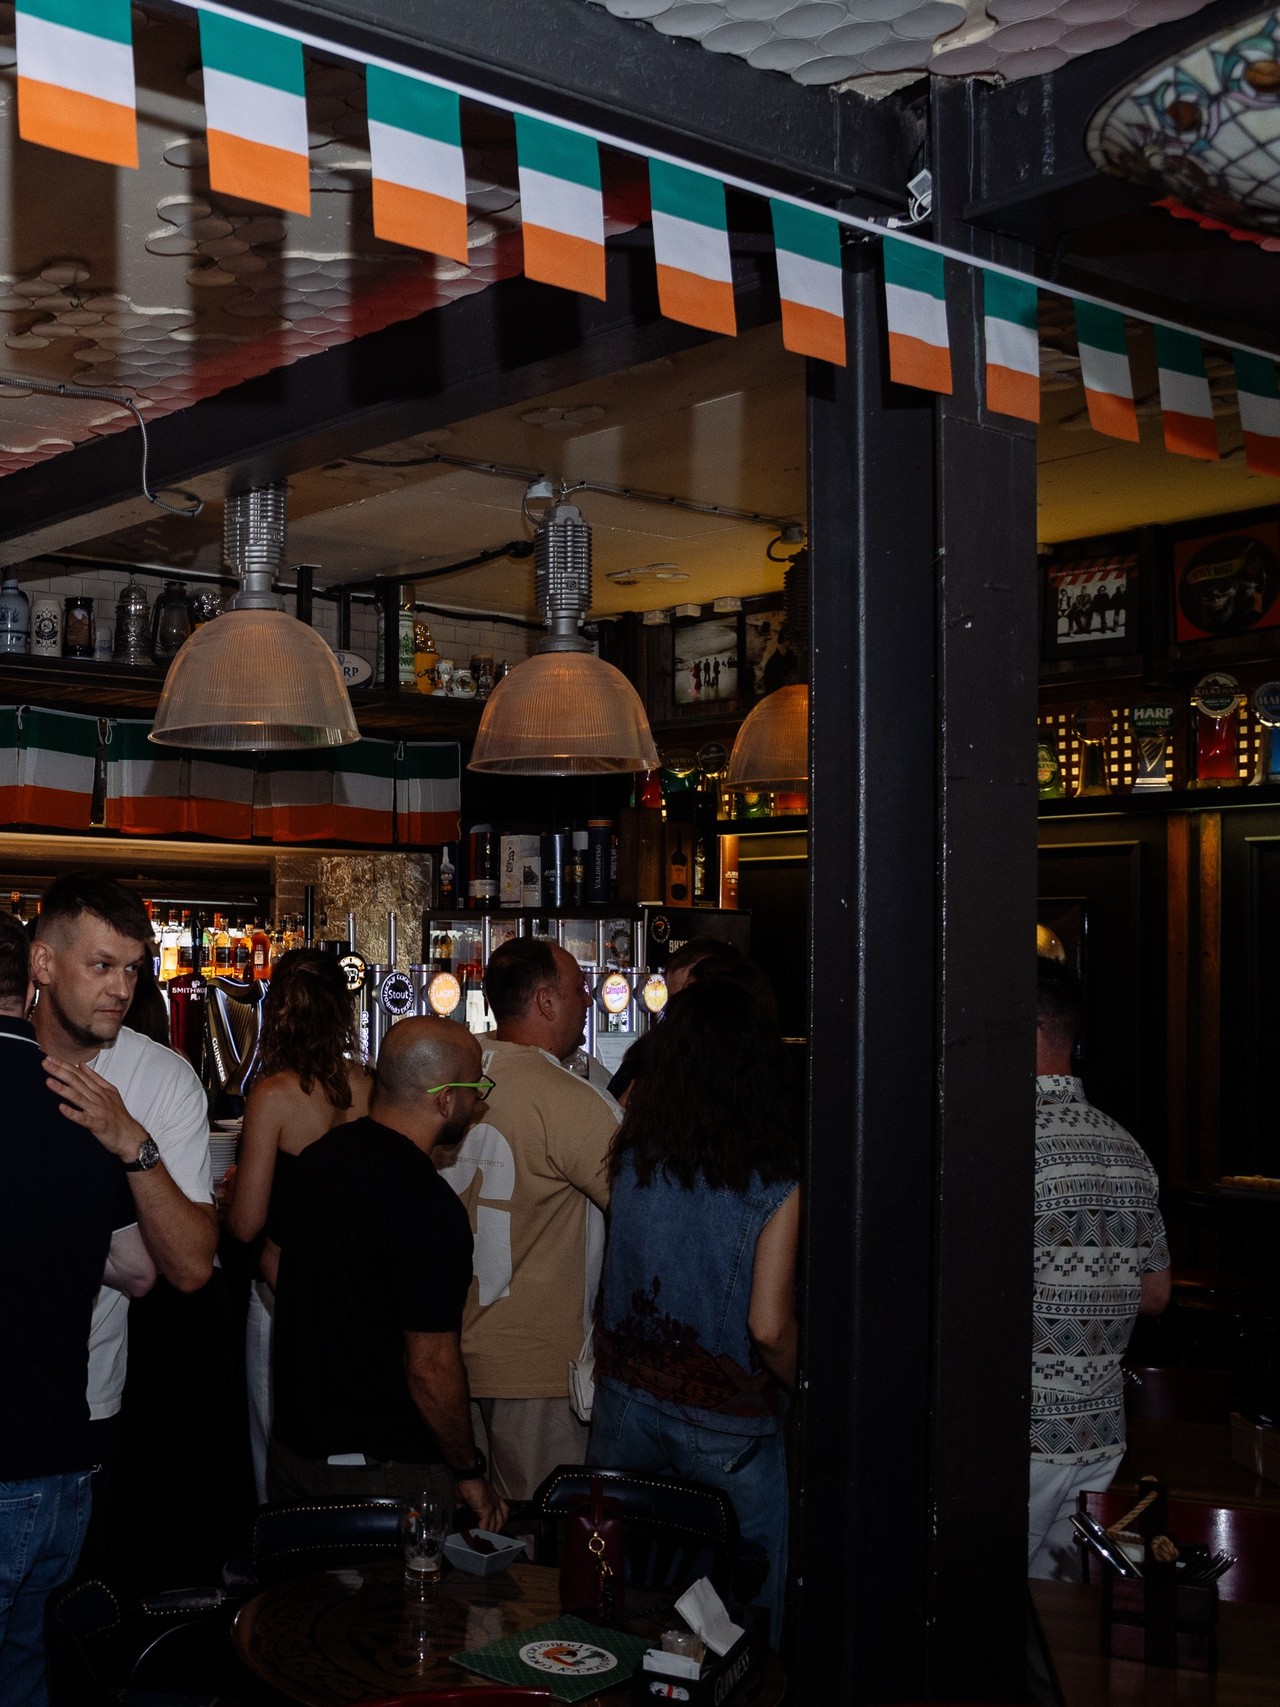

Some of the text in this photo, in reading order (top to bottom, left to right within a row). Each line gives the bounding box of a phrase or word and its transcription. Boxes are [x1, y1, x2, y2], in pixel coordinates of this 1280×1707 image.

[1194, 687, 1240, 696] KILKENNY
[1133, 707, 1174, 720] HARP
[594, 844, 602, 889] VALDESPINO
[388, 989, 409, 1000] Stout
[212, 1037, 227, 1082] GUINNESS
